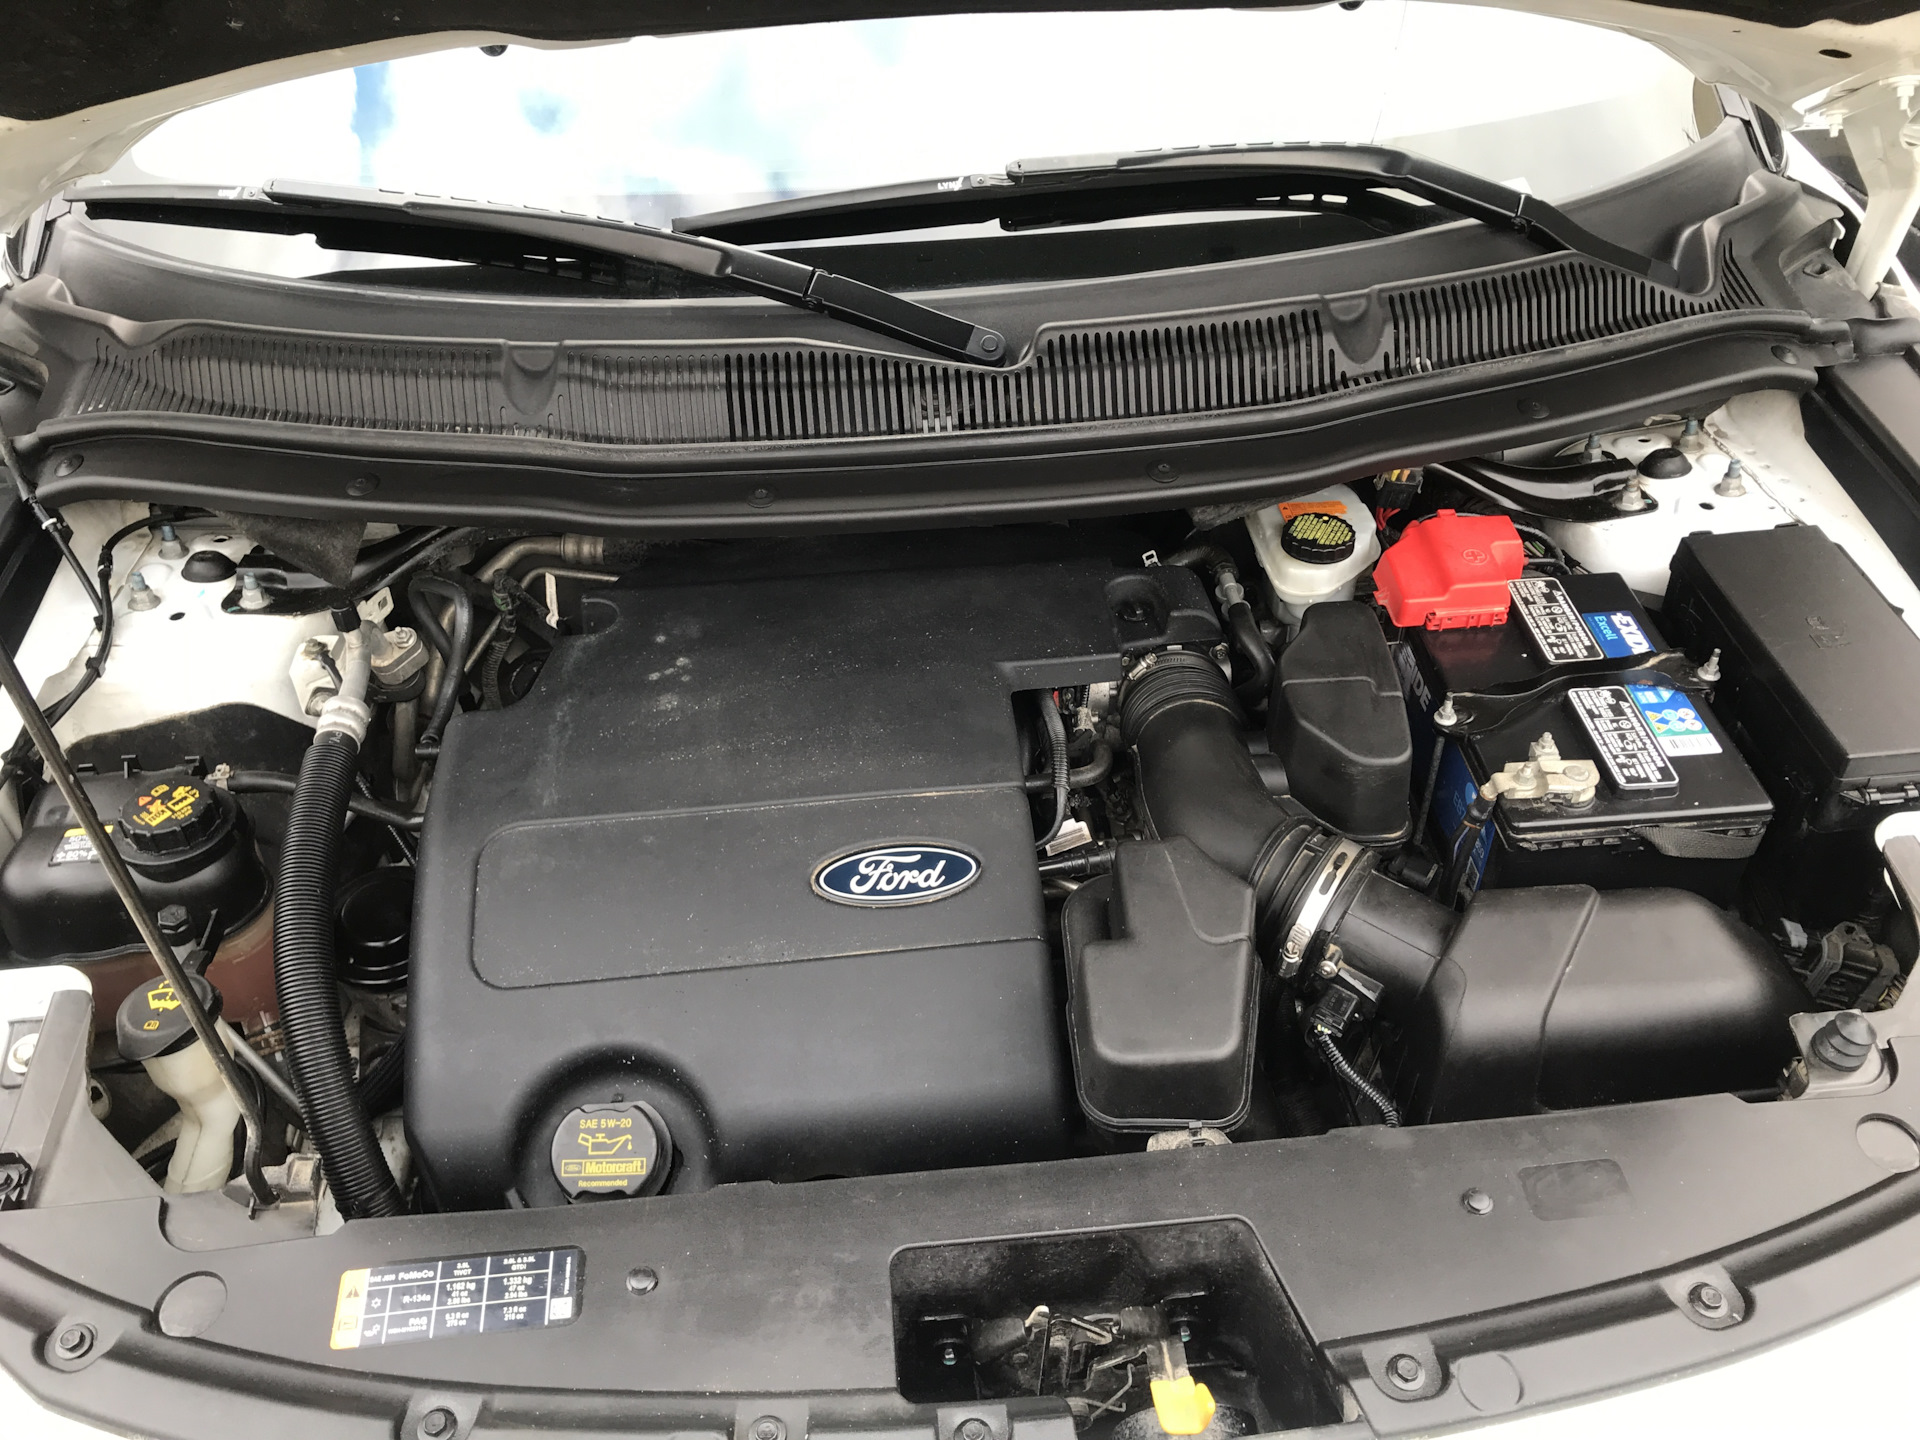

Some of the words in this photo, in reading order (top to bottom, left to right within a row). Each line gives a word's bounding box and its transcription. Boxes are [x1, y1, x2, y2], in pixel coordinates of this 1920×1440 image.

[1556, 595, 1591, 645] DANGER/POISON
[1594, 615, 1618, 641] Excell
[1622, 707, 1665, 766] DANGER/POISON
[850, 854, 946, 894] Ford
[579, 1118, 598, 1129] SAE
[600, 1117, 632, 1128] 5W-20
[585, 1161, 642, 1174] Motorcraft
[578, 1179, 628, 1187] Recommended
[398, 1269, 435, 1281] FoMoCo
[522, 1275, 533, 1285] kg
[466, 1281, 476, 1291] kg
[402, 1293, 431, 1304] R-134a
[409, 1316, 428, 1327] PAG
